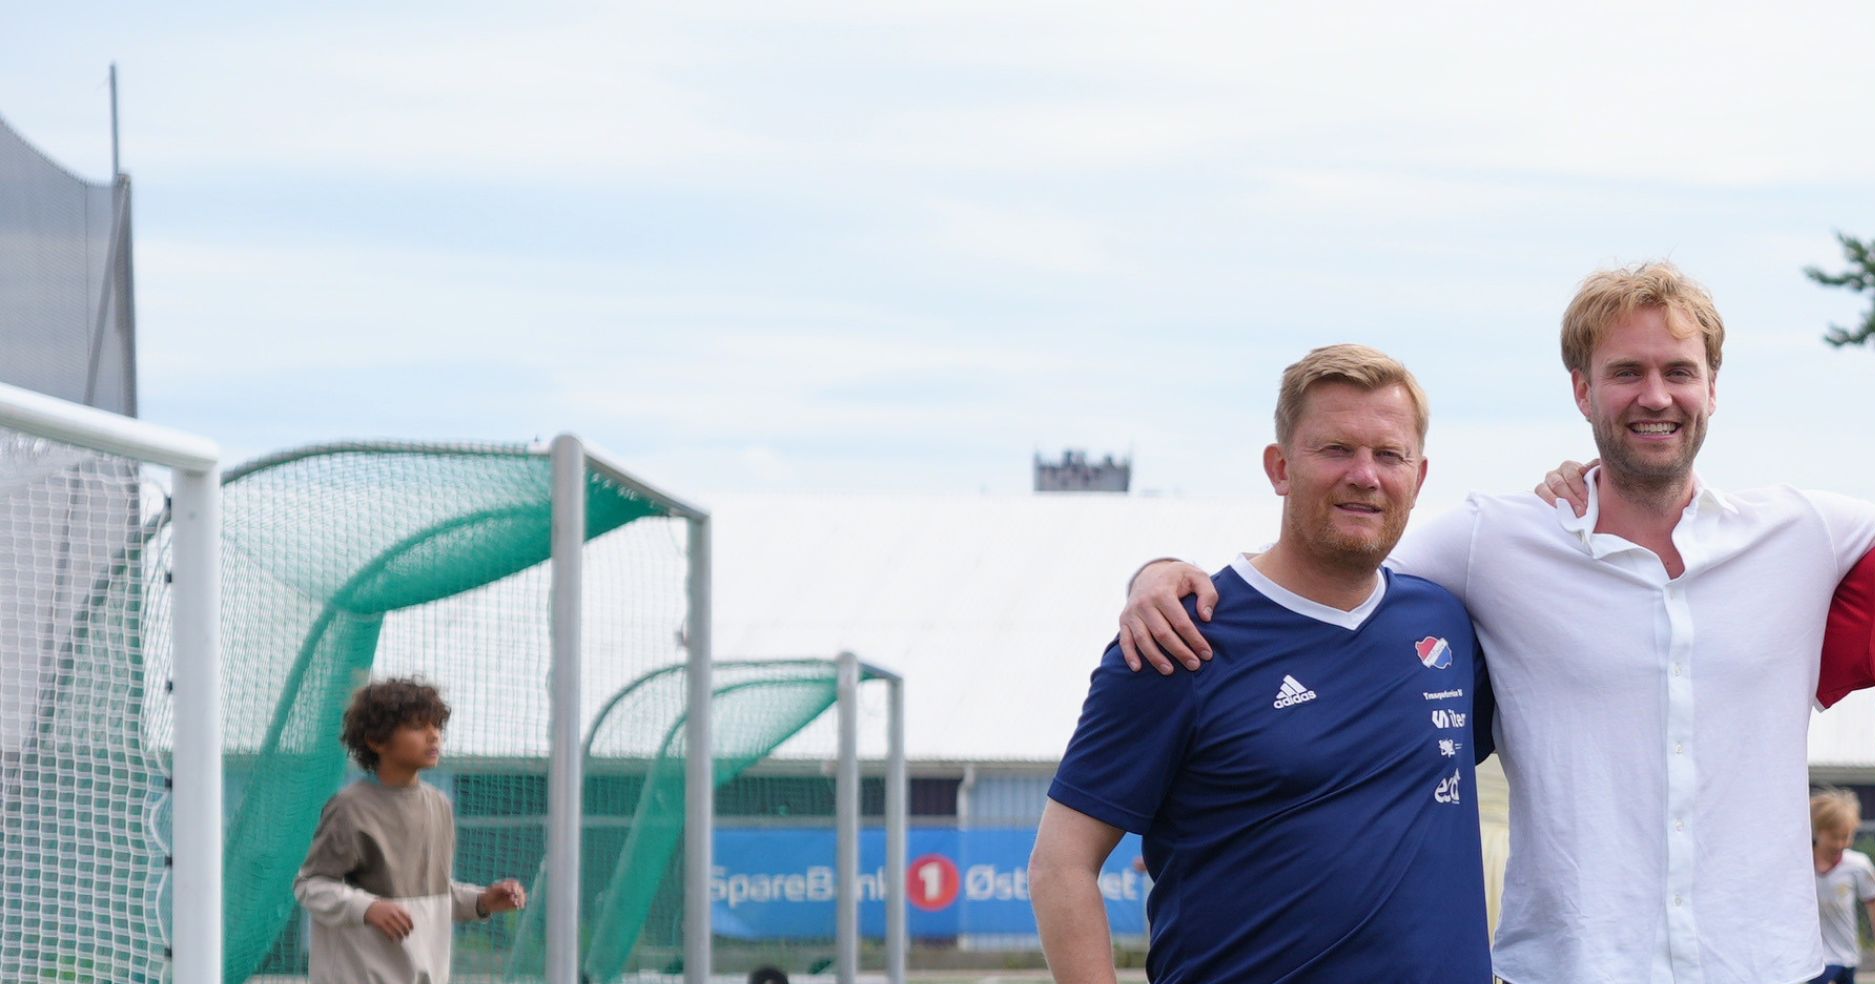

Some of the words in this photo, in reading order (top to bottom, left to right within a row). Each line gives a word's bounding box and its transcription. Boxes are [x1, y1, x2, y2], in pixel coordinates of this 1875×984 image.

[1273, 690, 1317, 709] adidas
[711, 865, 886, 909] SpareBn
[918, 862, 942, 901] 1
[966, 864, 1138, 901] Østet
